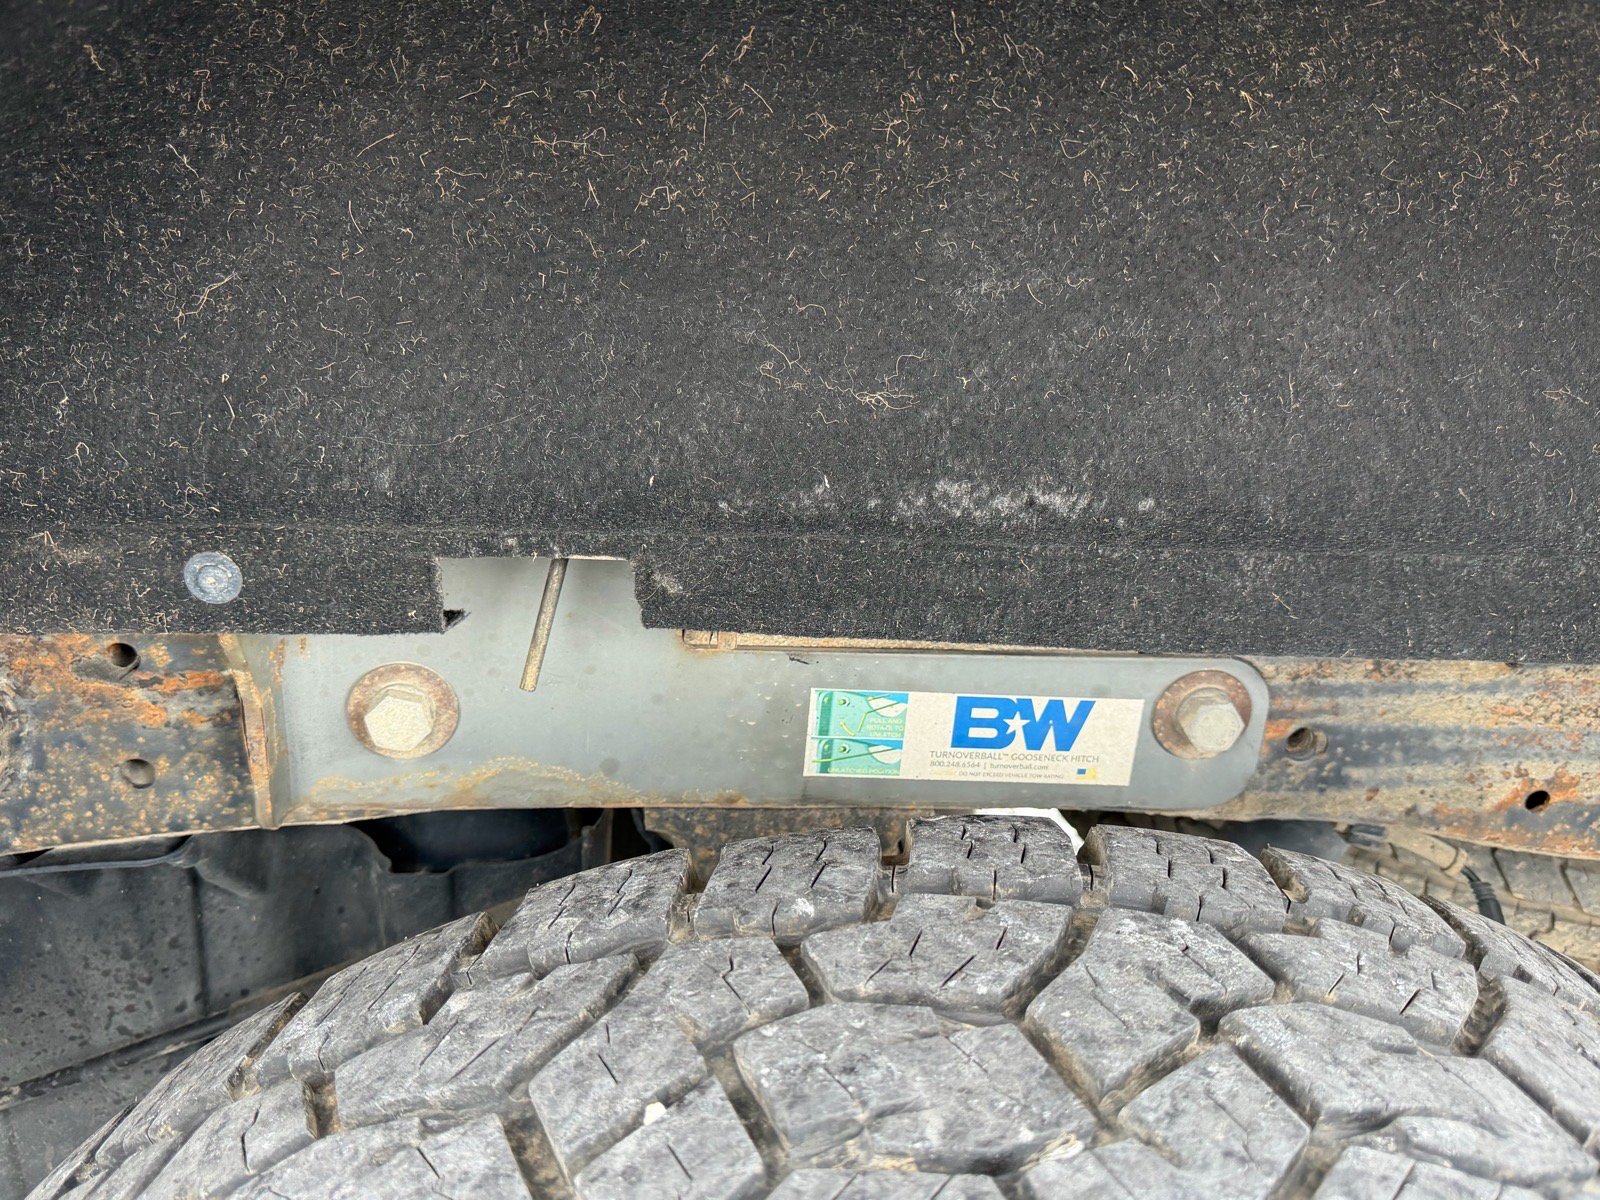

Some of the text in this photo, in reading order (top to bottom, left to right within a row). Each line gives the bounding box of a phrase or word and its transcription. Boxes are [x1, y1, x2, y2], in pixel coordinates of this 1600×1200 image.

[1011, 753, 1069, 762] GOOSENECK
[1070, 754, 1100, 763] HITCH
[929, 760, 1049, 771] 800.248.6564 turnoverball.com
